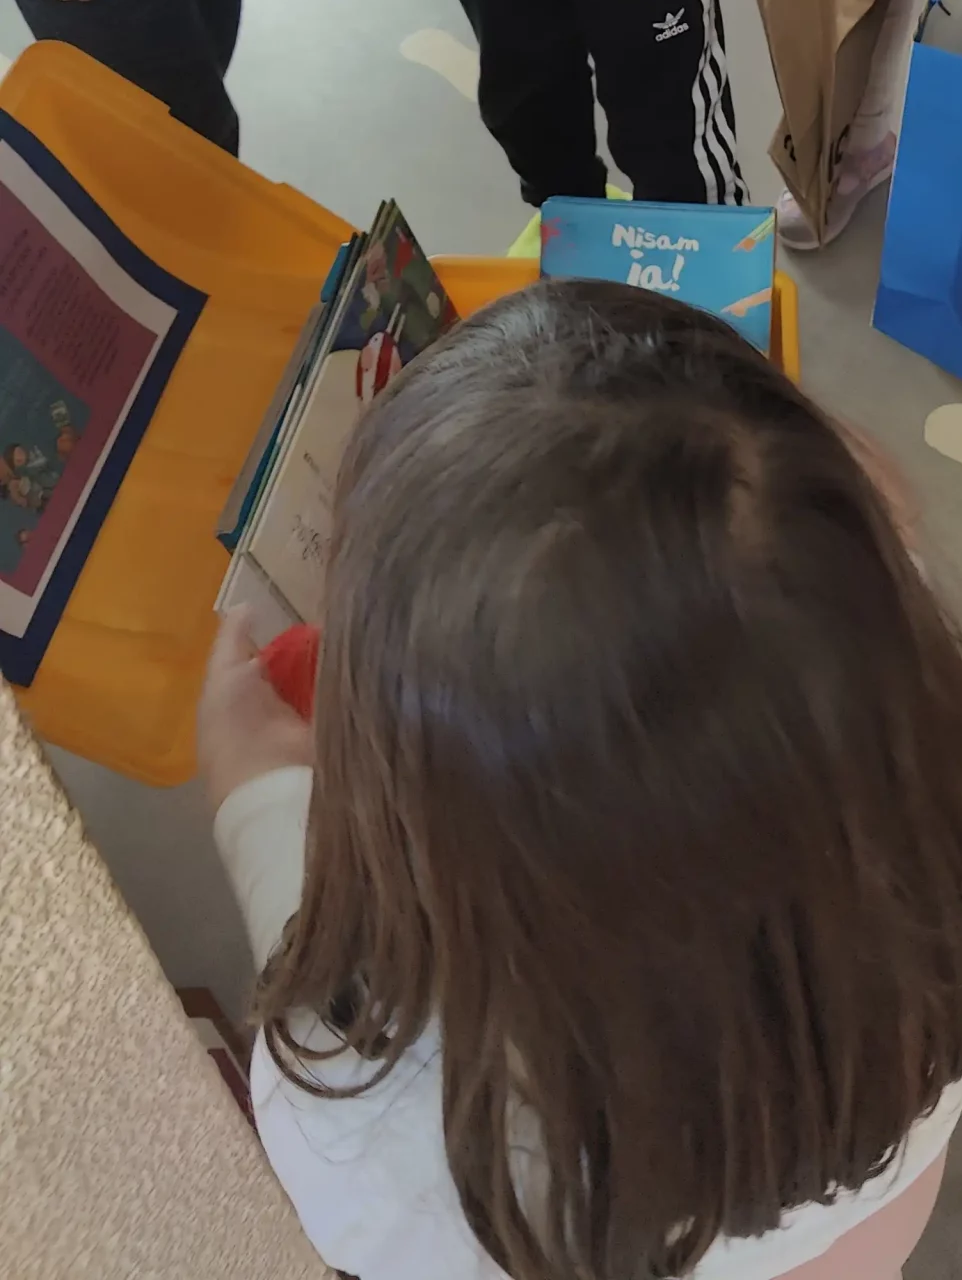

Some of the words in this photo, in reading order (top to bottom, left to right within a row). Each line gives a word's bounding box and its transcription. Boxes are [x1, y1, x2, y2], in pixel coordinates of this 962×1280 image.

[655, 22, 689, 41] adidas
[612, 223, 699, 251] Nisam
[626, 249, 685, 292] ja!
